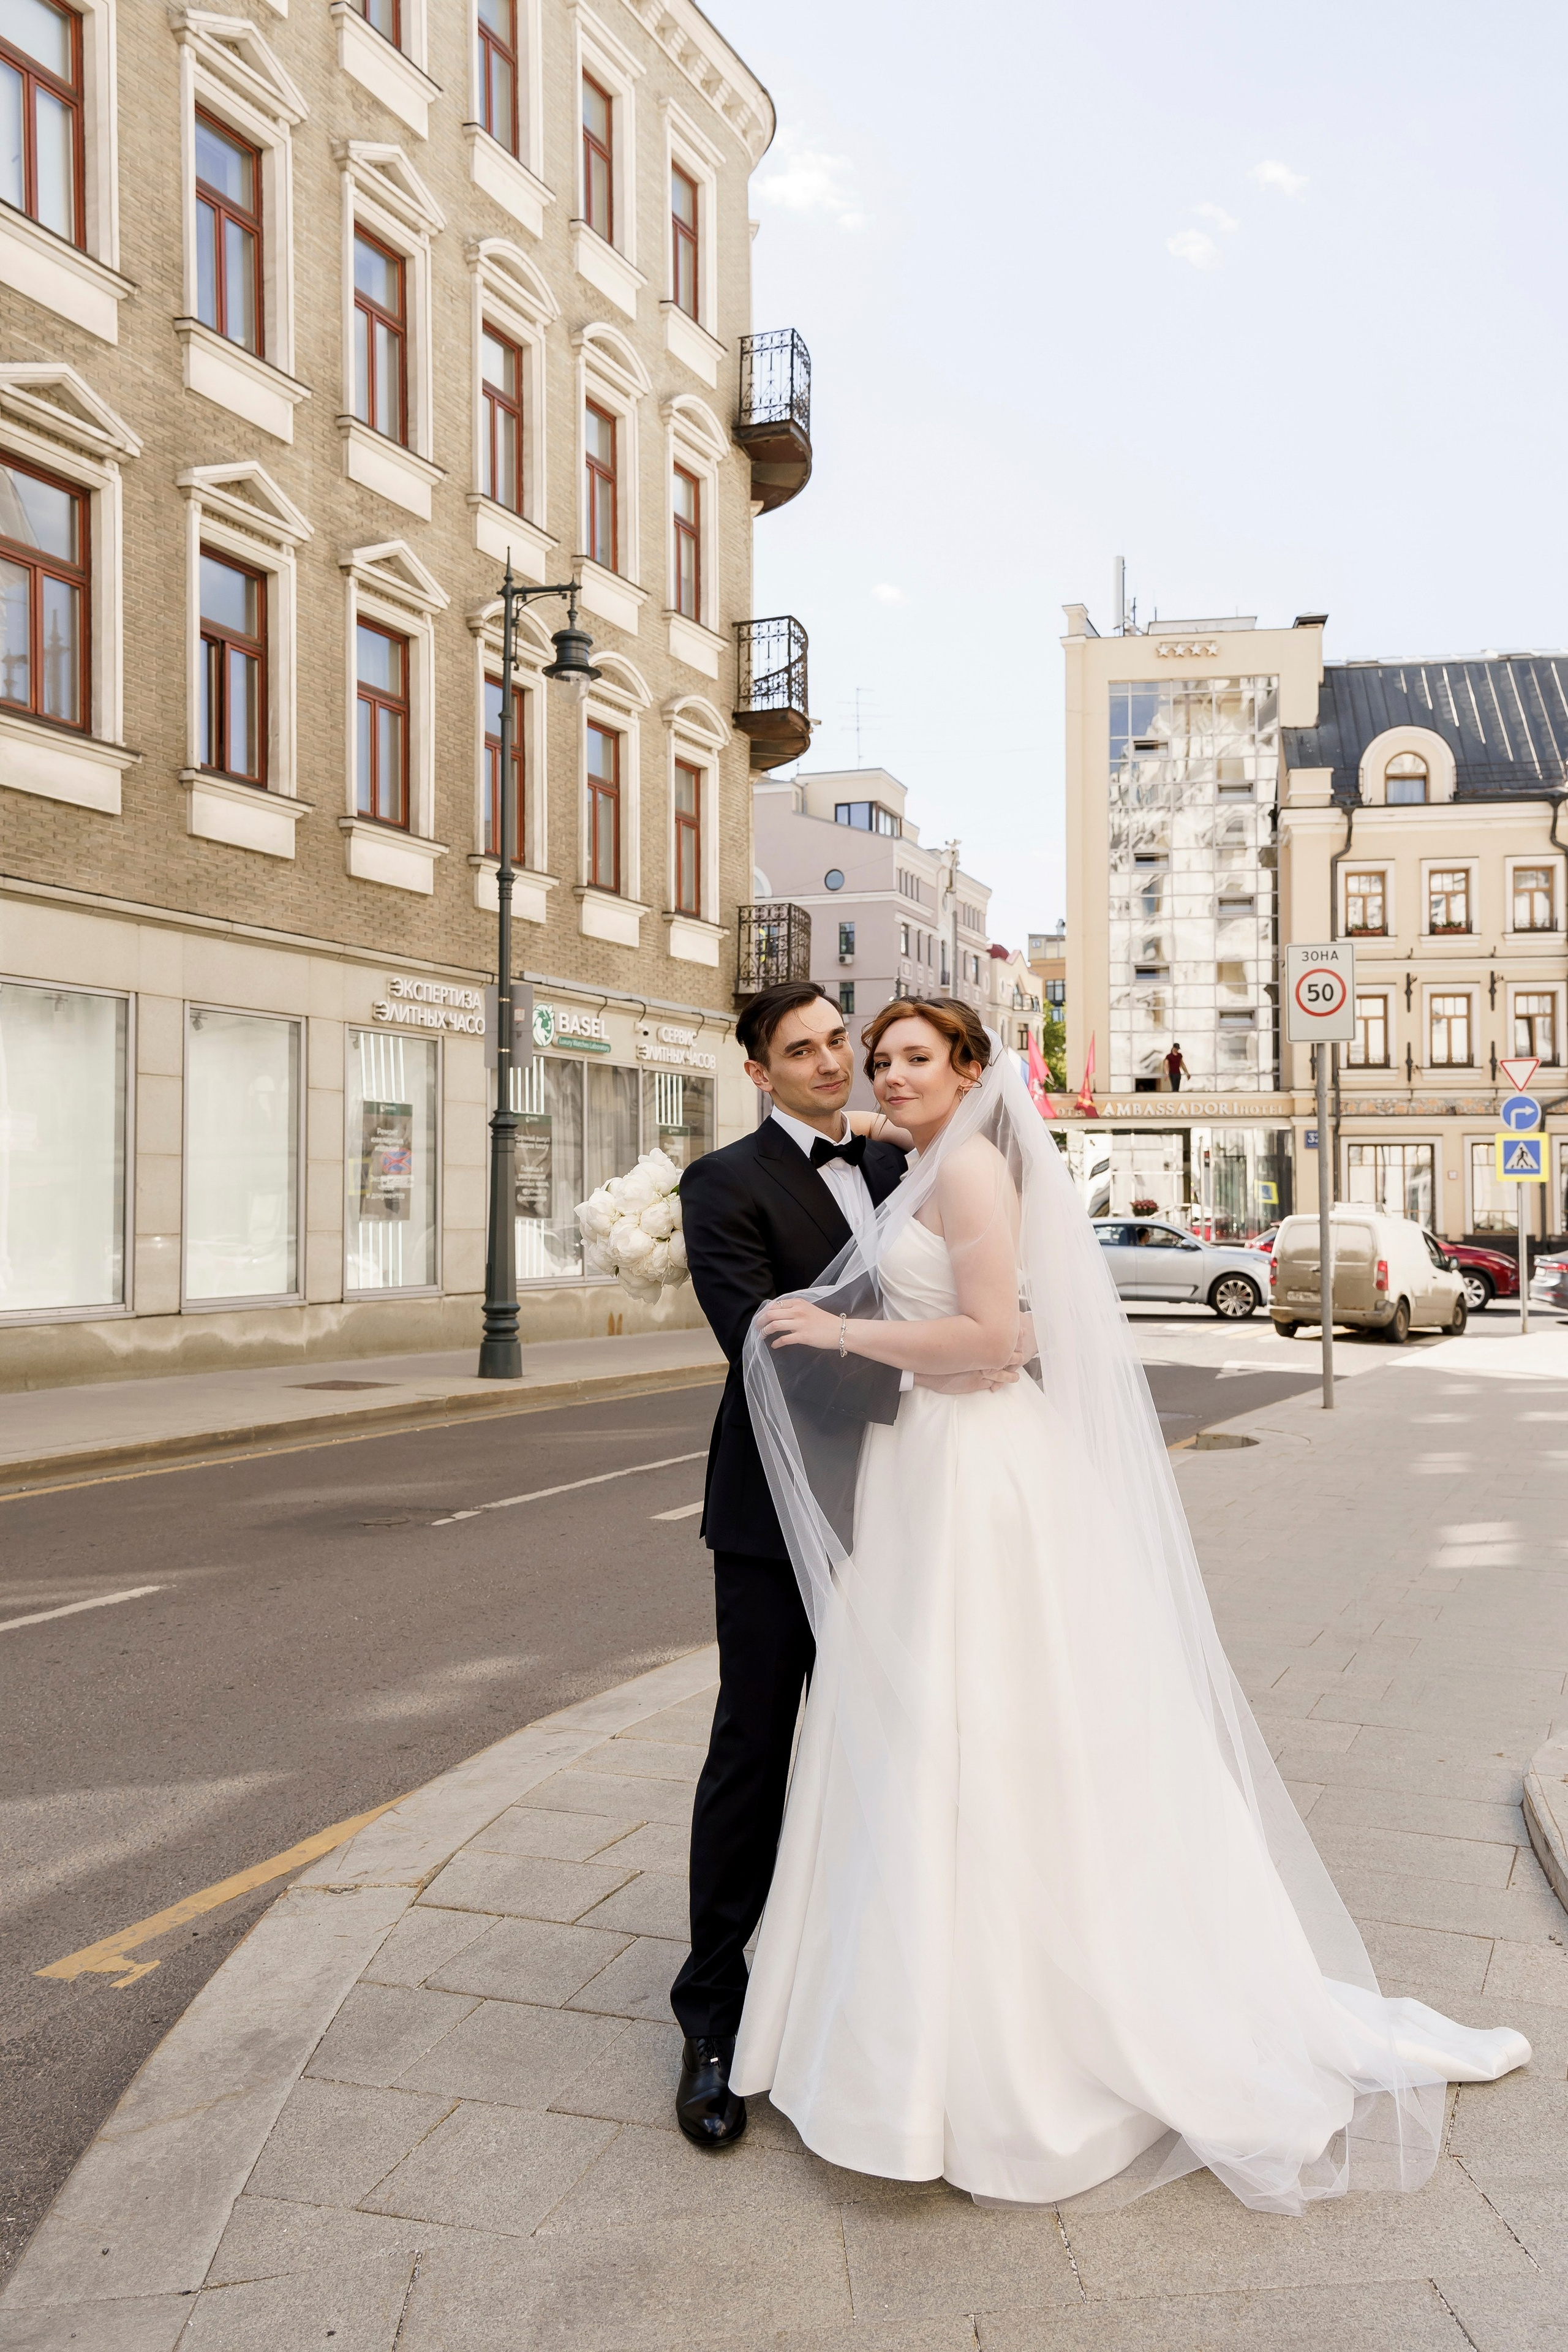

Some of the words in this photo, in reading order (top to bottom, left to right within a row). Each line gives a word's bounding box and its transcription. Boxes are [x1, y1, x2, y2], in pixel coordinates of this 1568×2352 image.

[1302, 951, 1339, 962] ЗОНА
[389, 977, 482, 1010] ЭКСПЕРТИЗА
[1307, 983, 1334, 1002] 50
[375, 1000, 448, 1030] ЭЛИТНЫХ
[448, 1012, 486, 1035] ЧАСО
[559, 1012, 610, 1040] BASEL
[661, 1027, 698, 1047] СЕРВИС
[638, 1043, 685, 1065] ЭЛИТНЫХ
[685, 1049, 717, 1069] ЧАСОВ
[1101, 1102, 1238, 1117] AMBASSADORI
[1239, 1104, 1285, 1115] HOTEL
